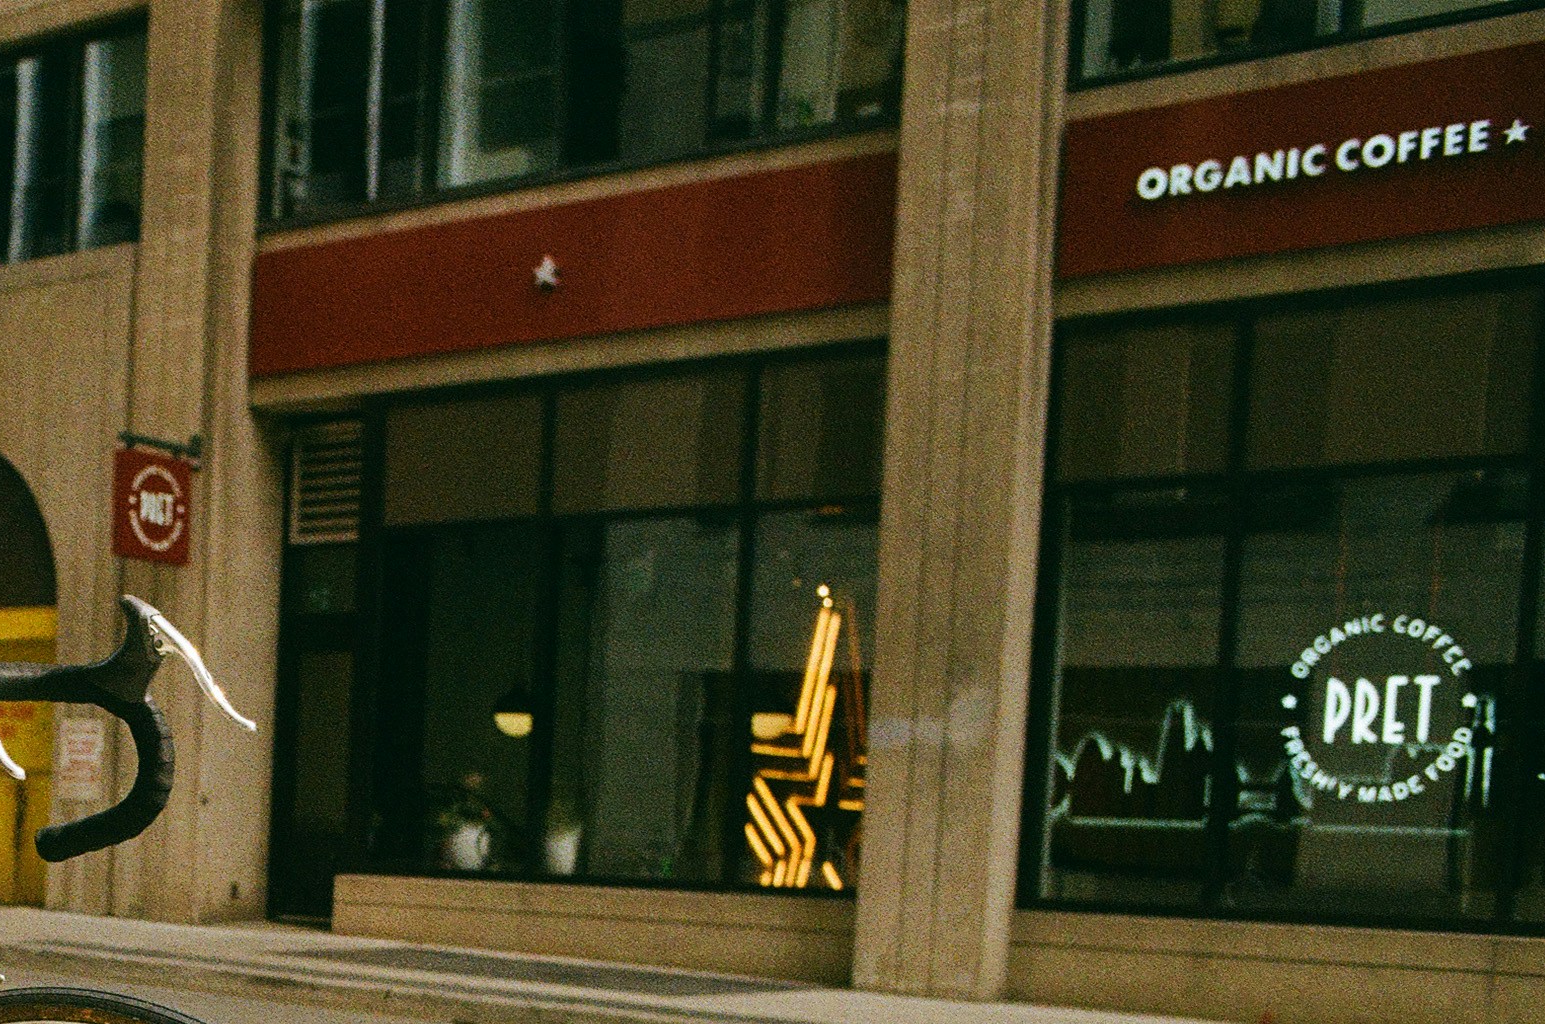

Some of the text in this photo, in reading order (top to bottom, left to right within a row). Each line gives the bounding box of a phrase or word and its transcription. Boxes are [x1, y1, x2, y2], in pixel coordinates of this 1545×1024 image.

[1136, 119, 1492, 200] ORGANIC COFFEE
[1291, 613, 1472, 679] ORGANIC COFFEE
[1322, 675, 1441, 745] PRET
[1357, 774, 1426, 803] MADE
[1424, 727, 1473, 782] FOOD
